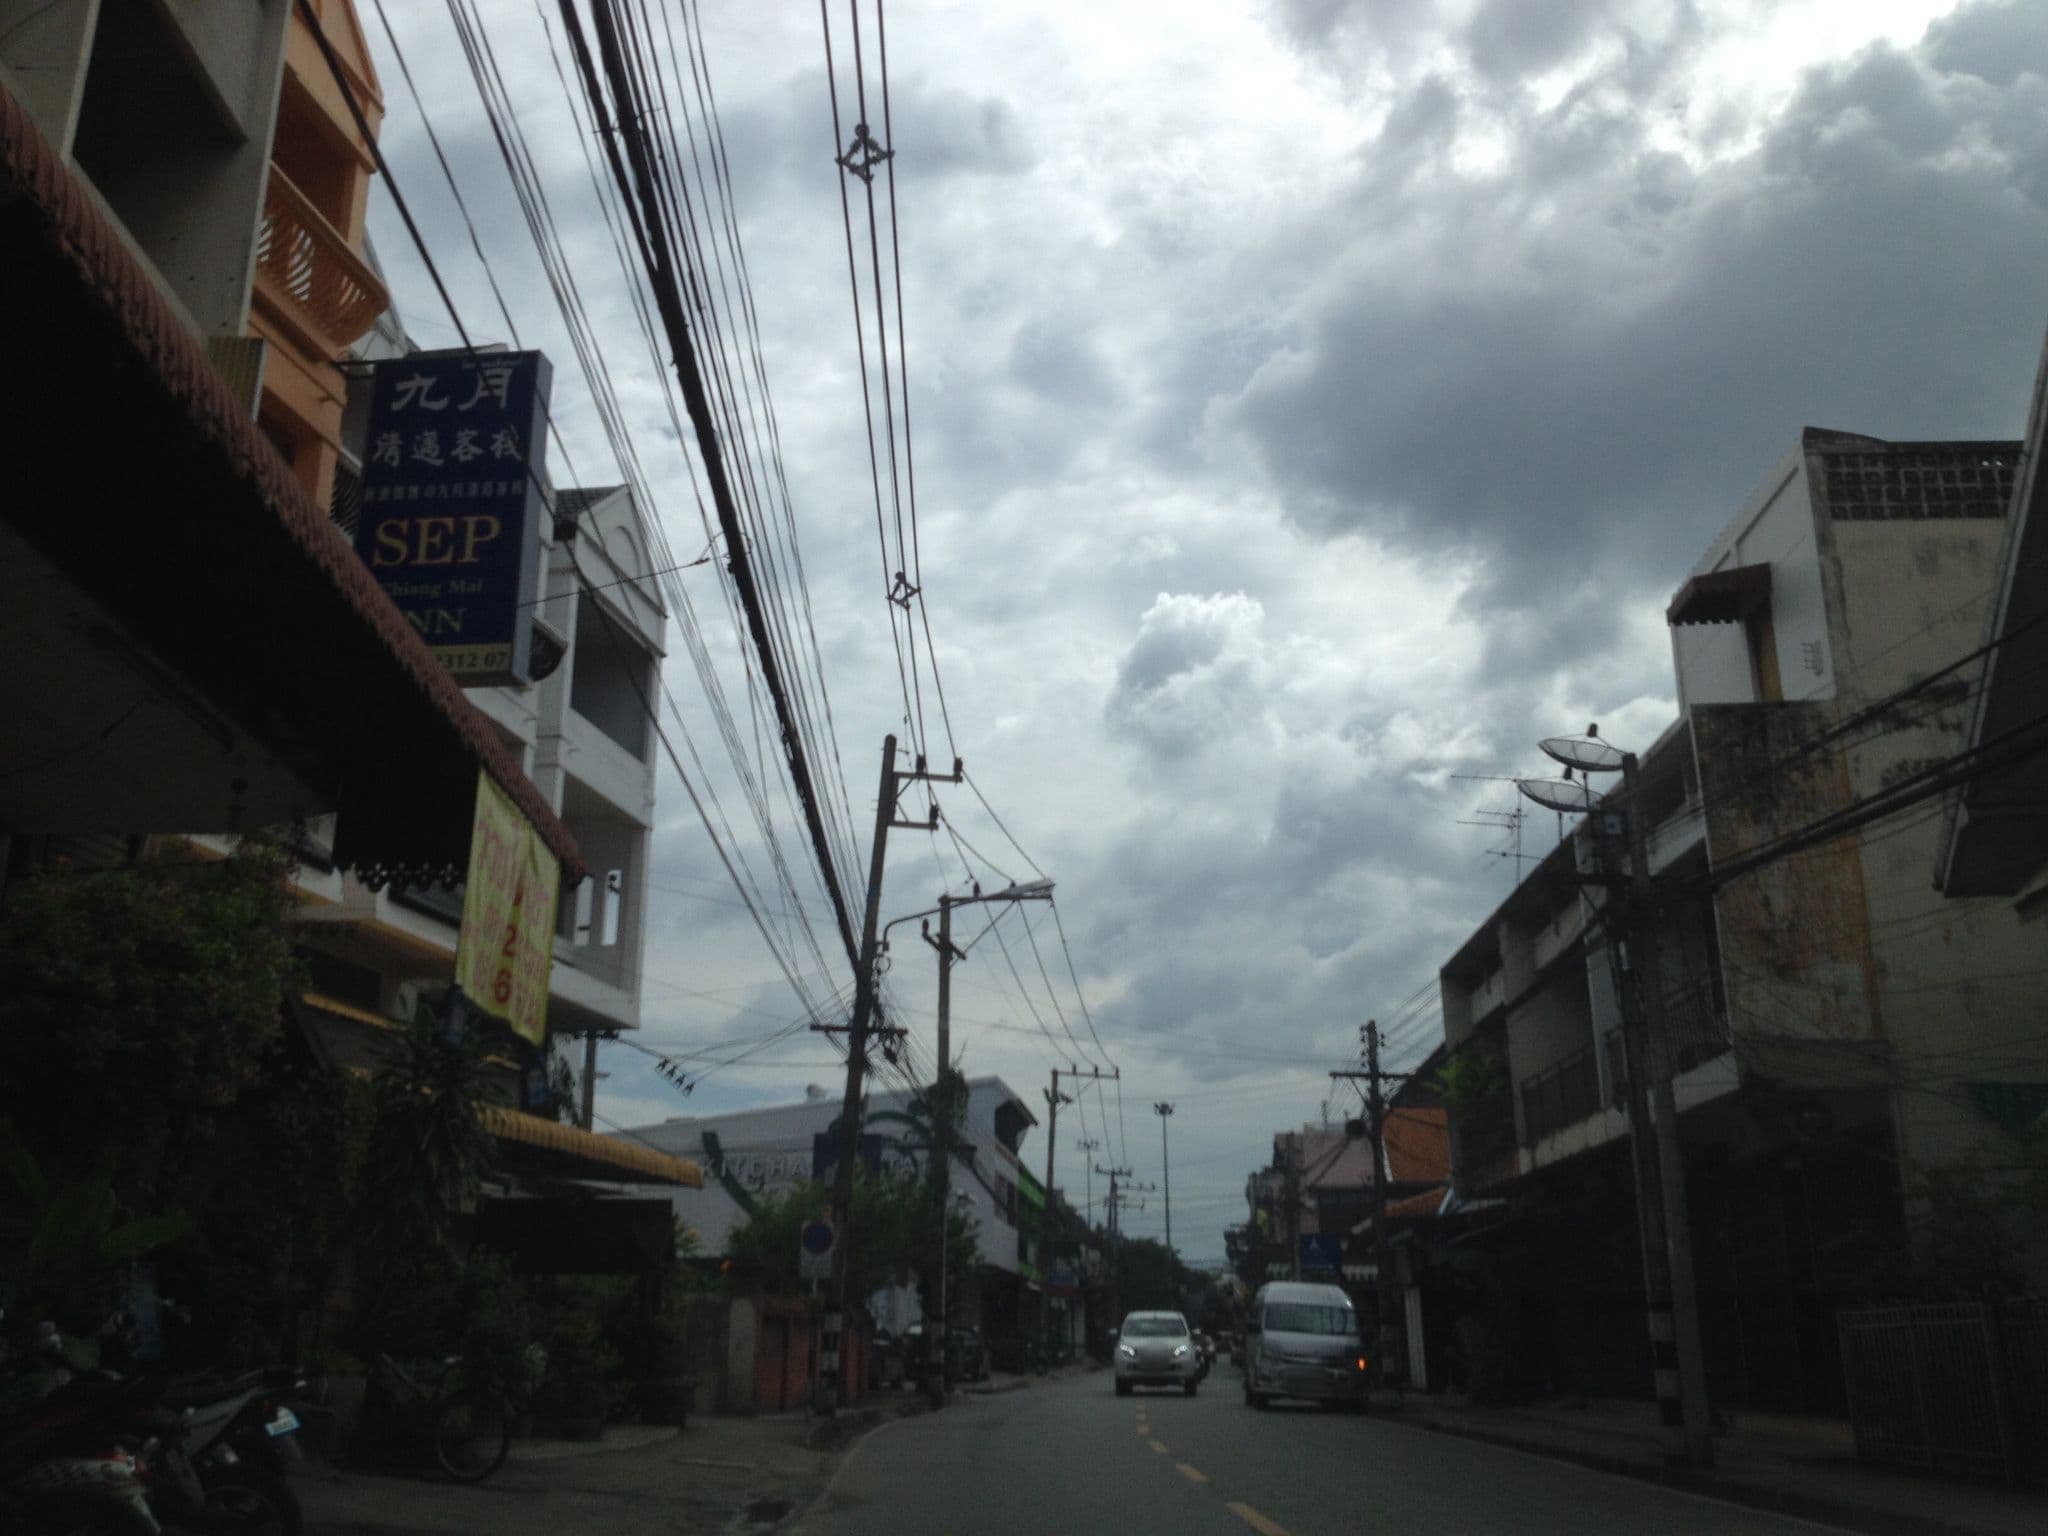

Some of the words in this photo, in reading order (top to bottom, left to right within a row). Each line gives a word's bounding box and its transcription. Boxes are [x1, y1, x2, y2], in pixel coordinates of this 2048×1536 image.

[390, 368, 513, 412] 九月
[372, 514, 503, 567] SEP
[448, 578, 484, 594] Mai
[407, 607, 468, 634] NN
[436, 652, 477, 669] 312
